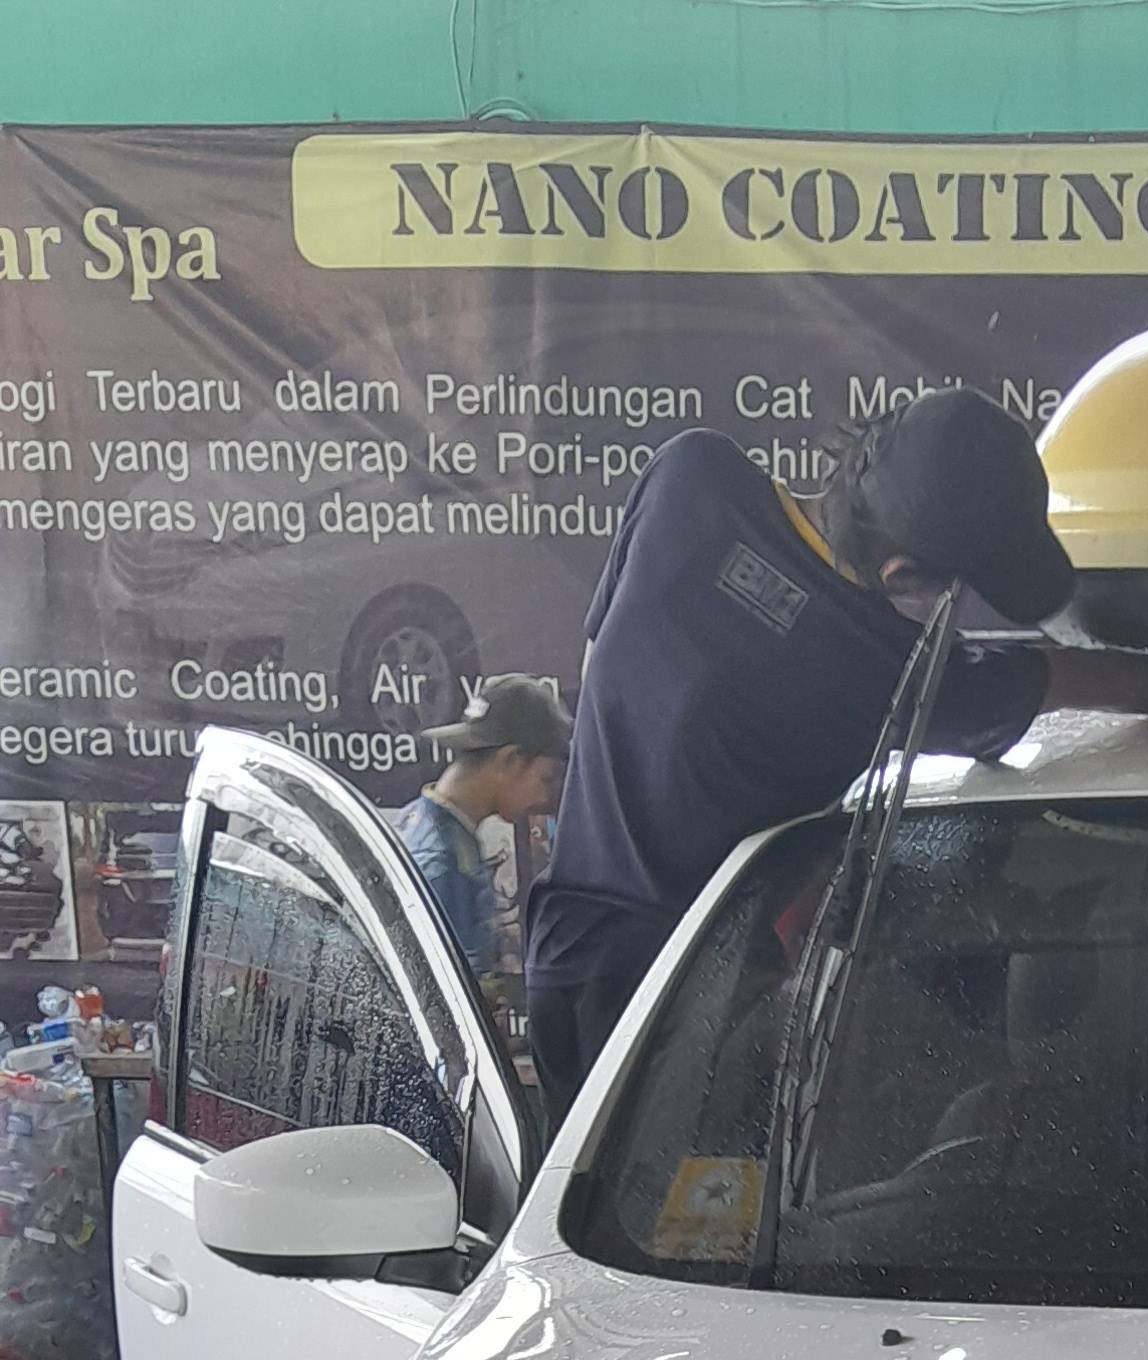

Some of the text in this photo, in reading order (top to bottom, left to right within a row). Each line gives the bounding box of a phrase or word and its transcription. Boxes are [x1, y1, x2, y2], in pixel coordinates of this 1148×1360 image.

[389, 161, 690, 240] NANO
[83, 206, 222, 301] Spa
[86, 370, 241, 412] Terbaru
[275, 370, 400, 412] dalam
[426, 373, 702, 428] Perlindungan
[735, 374, 813, 419] Cat
[90, 439, 190, 483] yang
[208, 440, 408, 483] menyerap
[428, 432, 477, 475] ke
[207, 500, 306, 544] yang
[319, 491, 435, 544] dapat
[171, 659, 340, 713] Coating,
[370, 662, 427, 705] Air
[0, 725, 114, 764] egera
